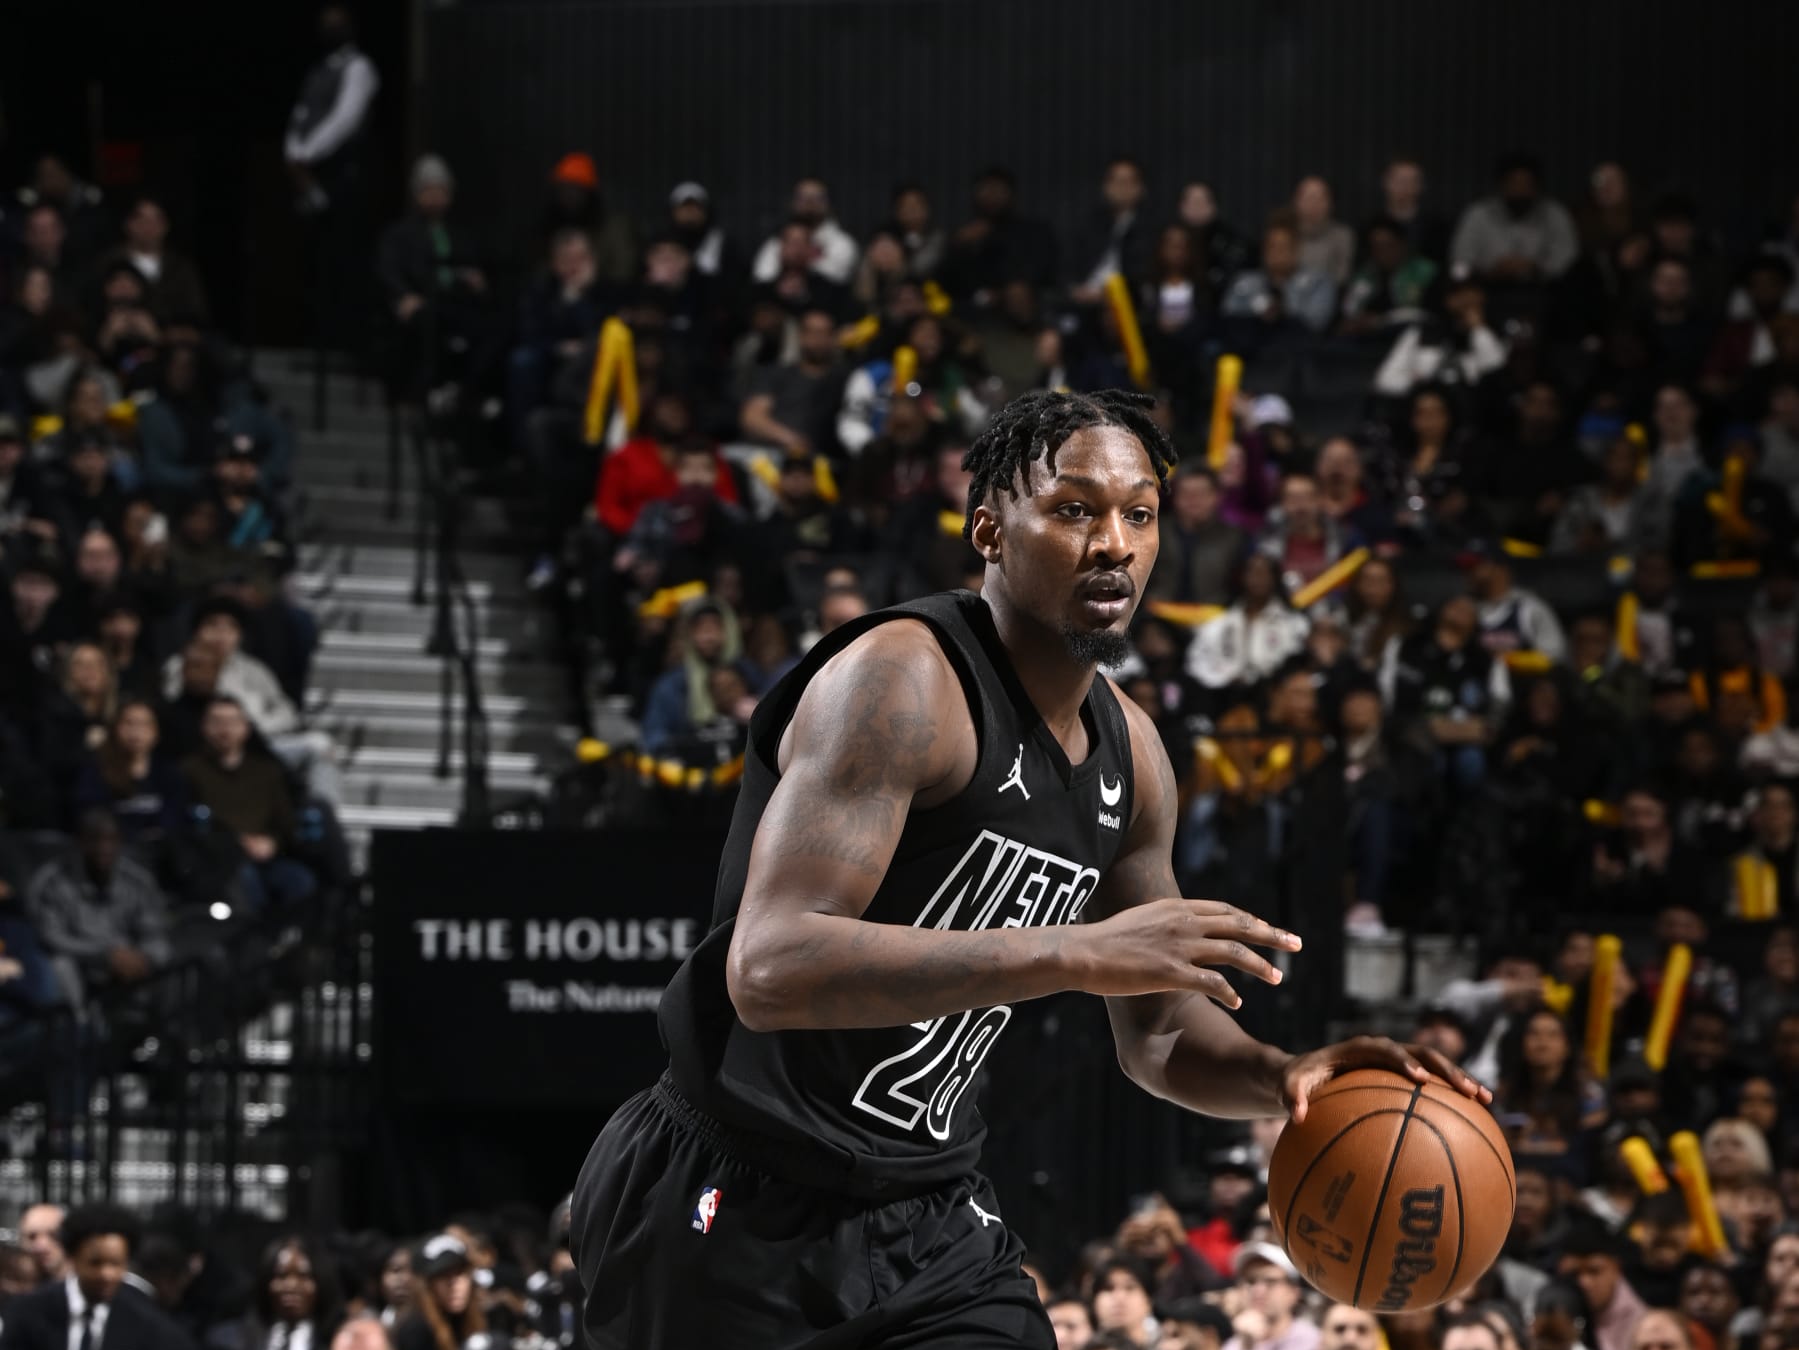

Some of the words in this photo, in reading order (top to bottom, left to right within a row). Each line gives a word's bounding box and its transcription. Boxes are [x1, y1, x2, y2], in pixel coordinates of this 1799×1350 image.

[1098, 810, 1121, 831] Webull
[414, 918, 513, 961] THE
[525, 917, 697, 962] HOUSE
[505, 979, 561, 1013] The
[852, 1004, 1012, 1140] 28
